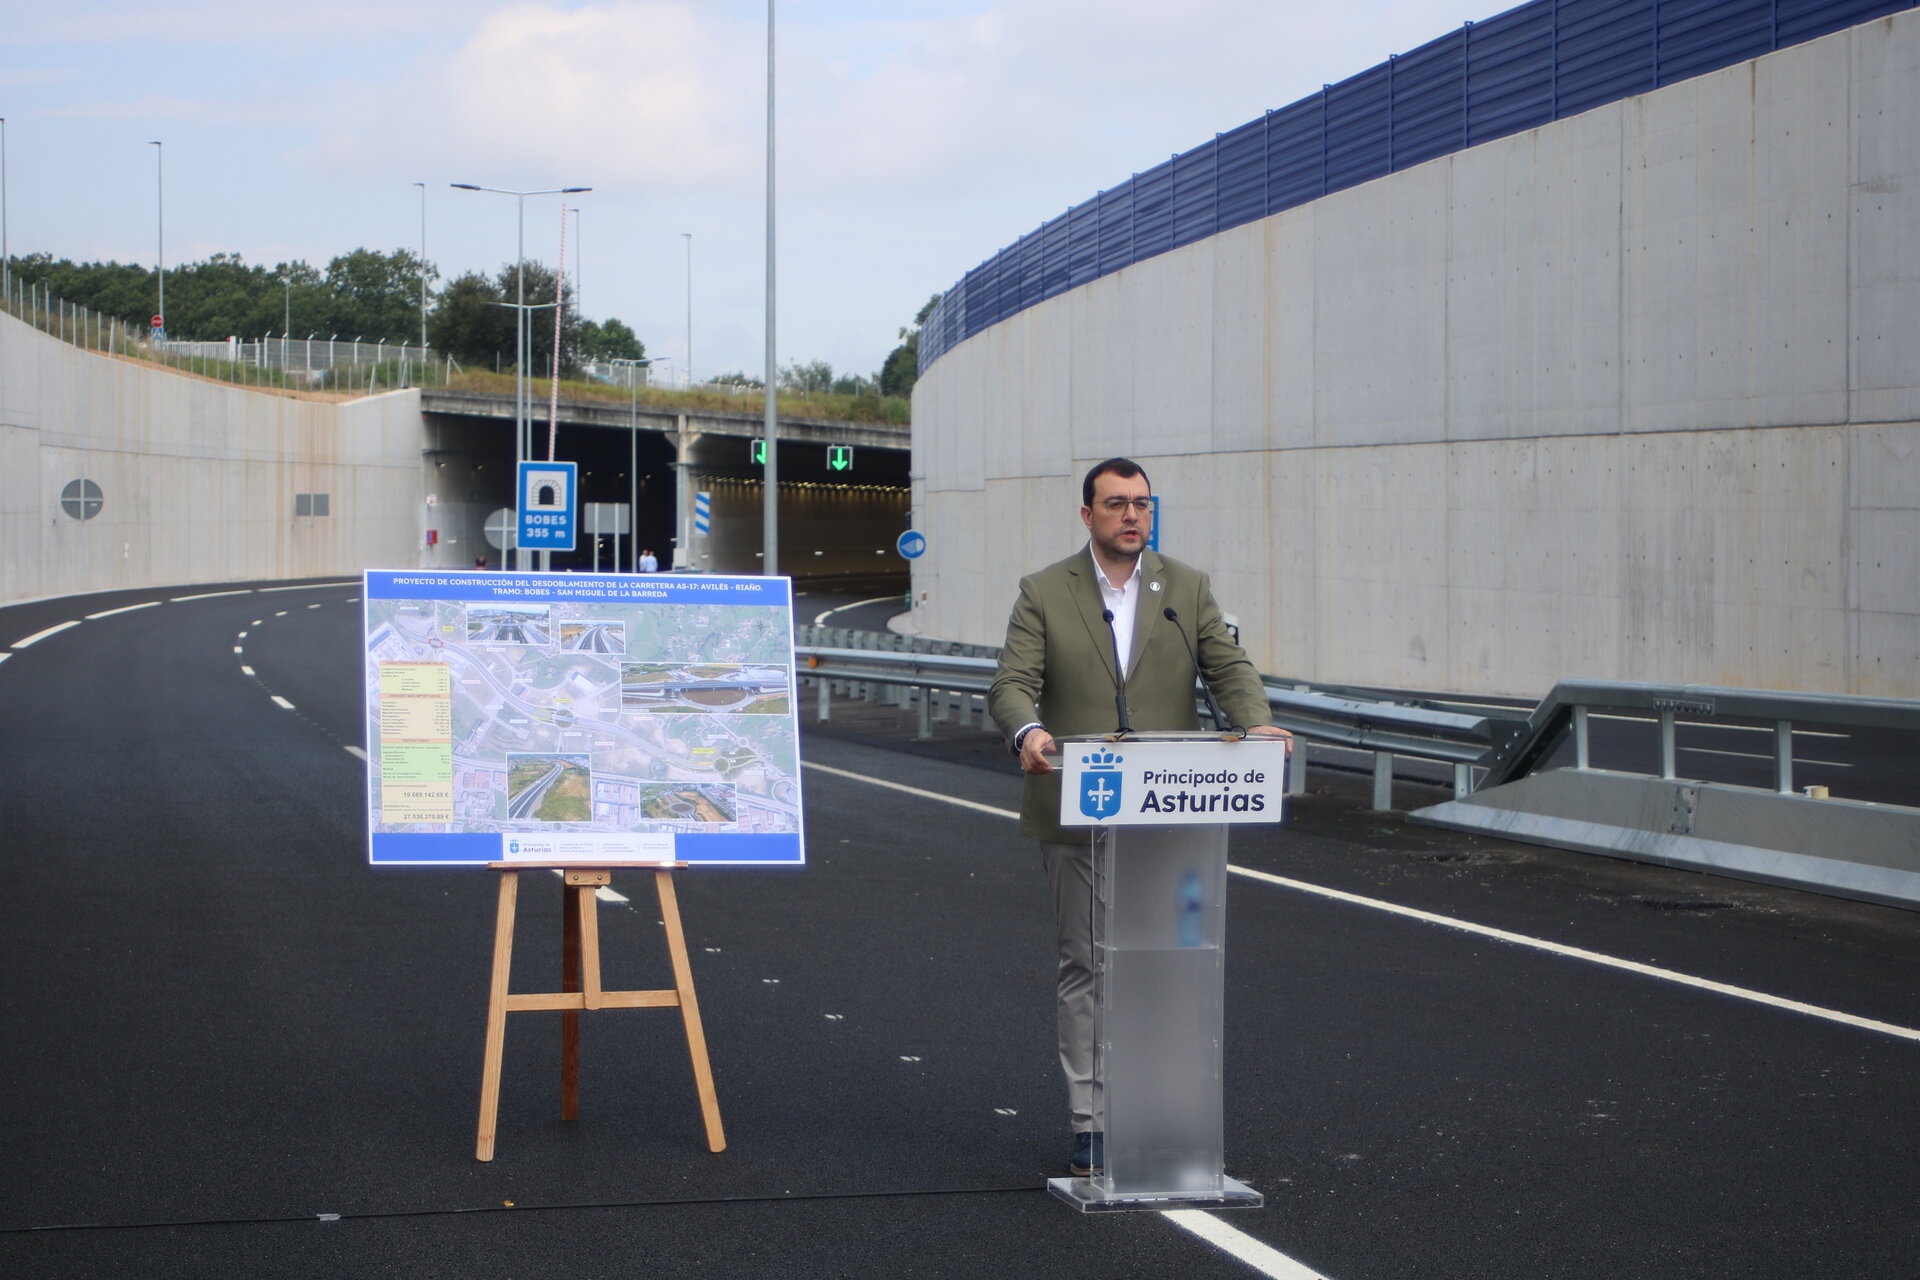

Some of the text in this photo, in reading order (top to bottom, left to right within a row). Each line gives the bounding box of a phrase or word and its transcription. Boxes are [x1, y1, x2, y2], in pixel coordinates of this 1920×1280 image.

[525, 515, 567, 525] BOBES
[526, 527, 566, 538] 355 m
[393, 578, 436, 586] PROYECTO
[450, 578, 513, 586] CONSTRUCCIÓN
[515, 579, 530, 587] DEL
[532, 580, 605, 588] DESDOBLAMIENTO
[606, 581, 617, 589] DE
[630, 582, 675, 590] CARRETERA
[701, 582, 728, 590] AVILÉS
[492, 587, 523, 595] TRAMO:
[524, 588, 550, 596] BOBES
[557, 588, 574, 596] SAN
[575, 589, 606, 597] MIGUEL
[620, 590, 630, 598] LA
[631, 590, 668, 598] BARREDA
[1143, 769, 1265, 787] Principado de
[1140, 786, 1265, 813] Asturias
